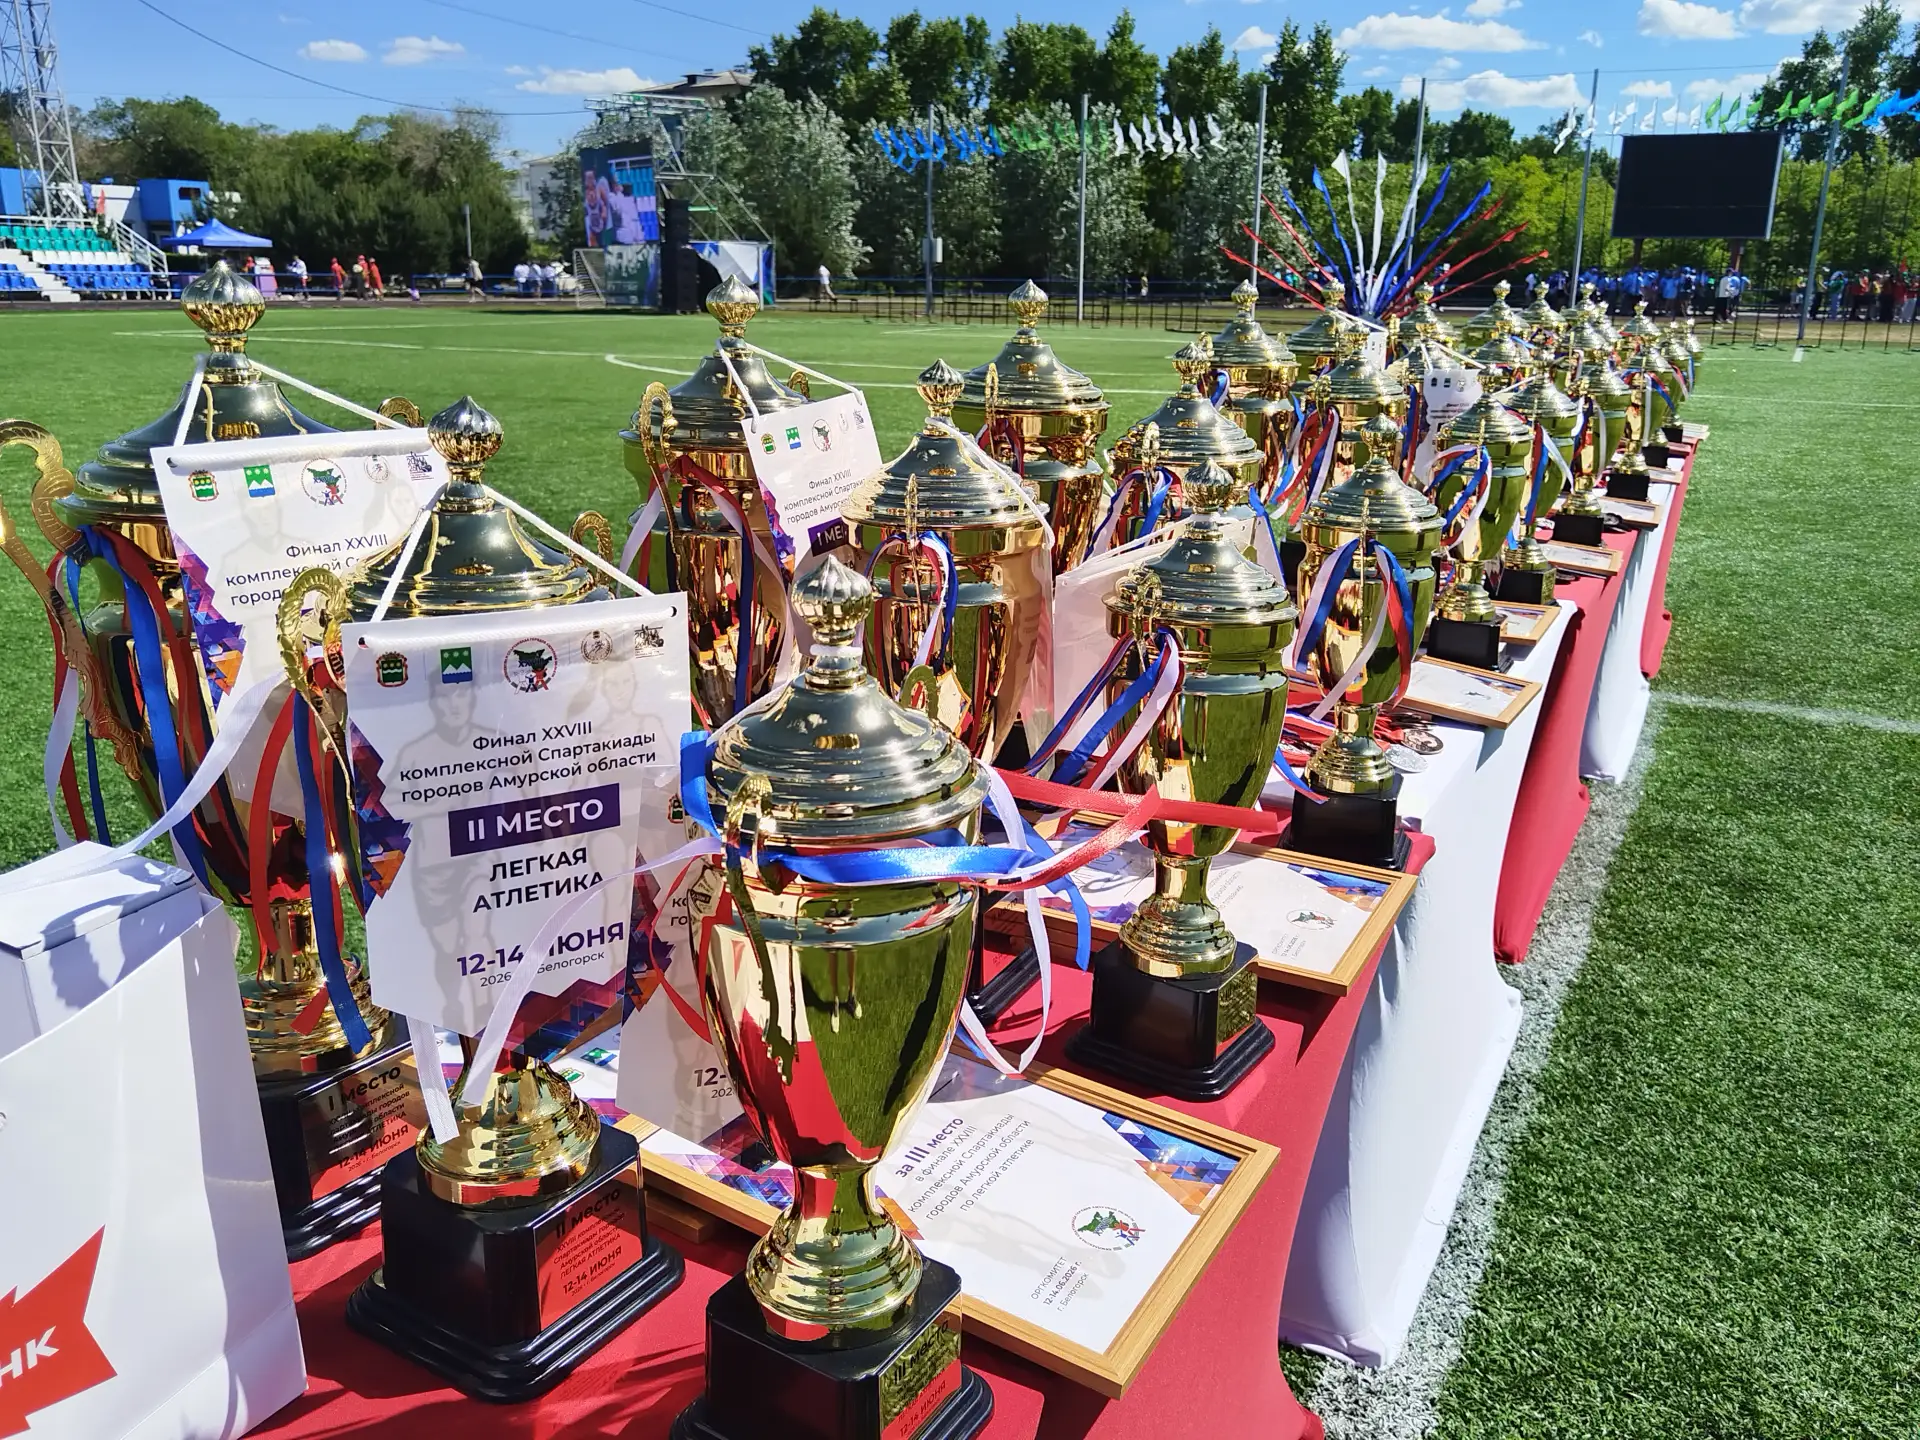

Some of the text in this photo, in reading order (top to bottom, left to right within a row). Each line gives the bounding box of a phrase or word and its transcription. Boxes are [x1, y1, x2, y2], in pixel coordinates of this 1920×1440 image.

[808, 469, 851, 489] Финал XXVIII
[784, 488, 833, 511] комплексной
[787, 509, 818, 524] городов
[286, 533, 388, 558] Финал XXVIII
[231, 589, 282, 605] город
[472, 721, 592, 750] Финал XXVIII
[400, 732, 656, 781] комплексной Спартакиады
[402, 752, 656, 802] городов Амурской области
[467, 799, 604, 842] II МЕСТО
[489, 847, 587, 882] ЛЕГКАЯ
[473, 872, 603, 913] АТЛЕТИКА
[457, 945, 524, 976] 12-14
[480, 972, 512, 987] 2026
[379, 1090, 410, 1112] городов
[711, 1087, 733, 1098] 202
[371, 1124, 409, 1152] ИЮНЯ
[895, 1118, 963, 1178] за III место
[921, 1146, 955, 1176] финале
[952, 1125, 977, 1147] XXVIII
[908, 1114, 1015, 1213] комплексной Спартакиады
[926, 1120, 1030, 1221] городов Амурской области
[960, 1138, 1035, 1213] по легкой атлетике
[553, 1231, 598, 1265] Спартакиады
[560, 1242, 593, 1270] Амурской
[560, 1233, 621, 1280] ЛЕГКАЯ АТЛЕТИКА
[563, 1245, 622, 1294] 12-14 ИЮНЯ
[1031, 1256, 1067, 1300] ОРГКОМИТЕТ
[1060, 1272, 1089, 1306] Белогорск
[920, 1380, 946, 1415] ИЮНЯ
